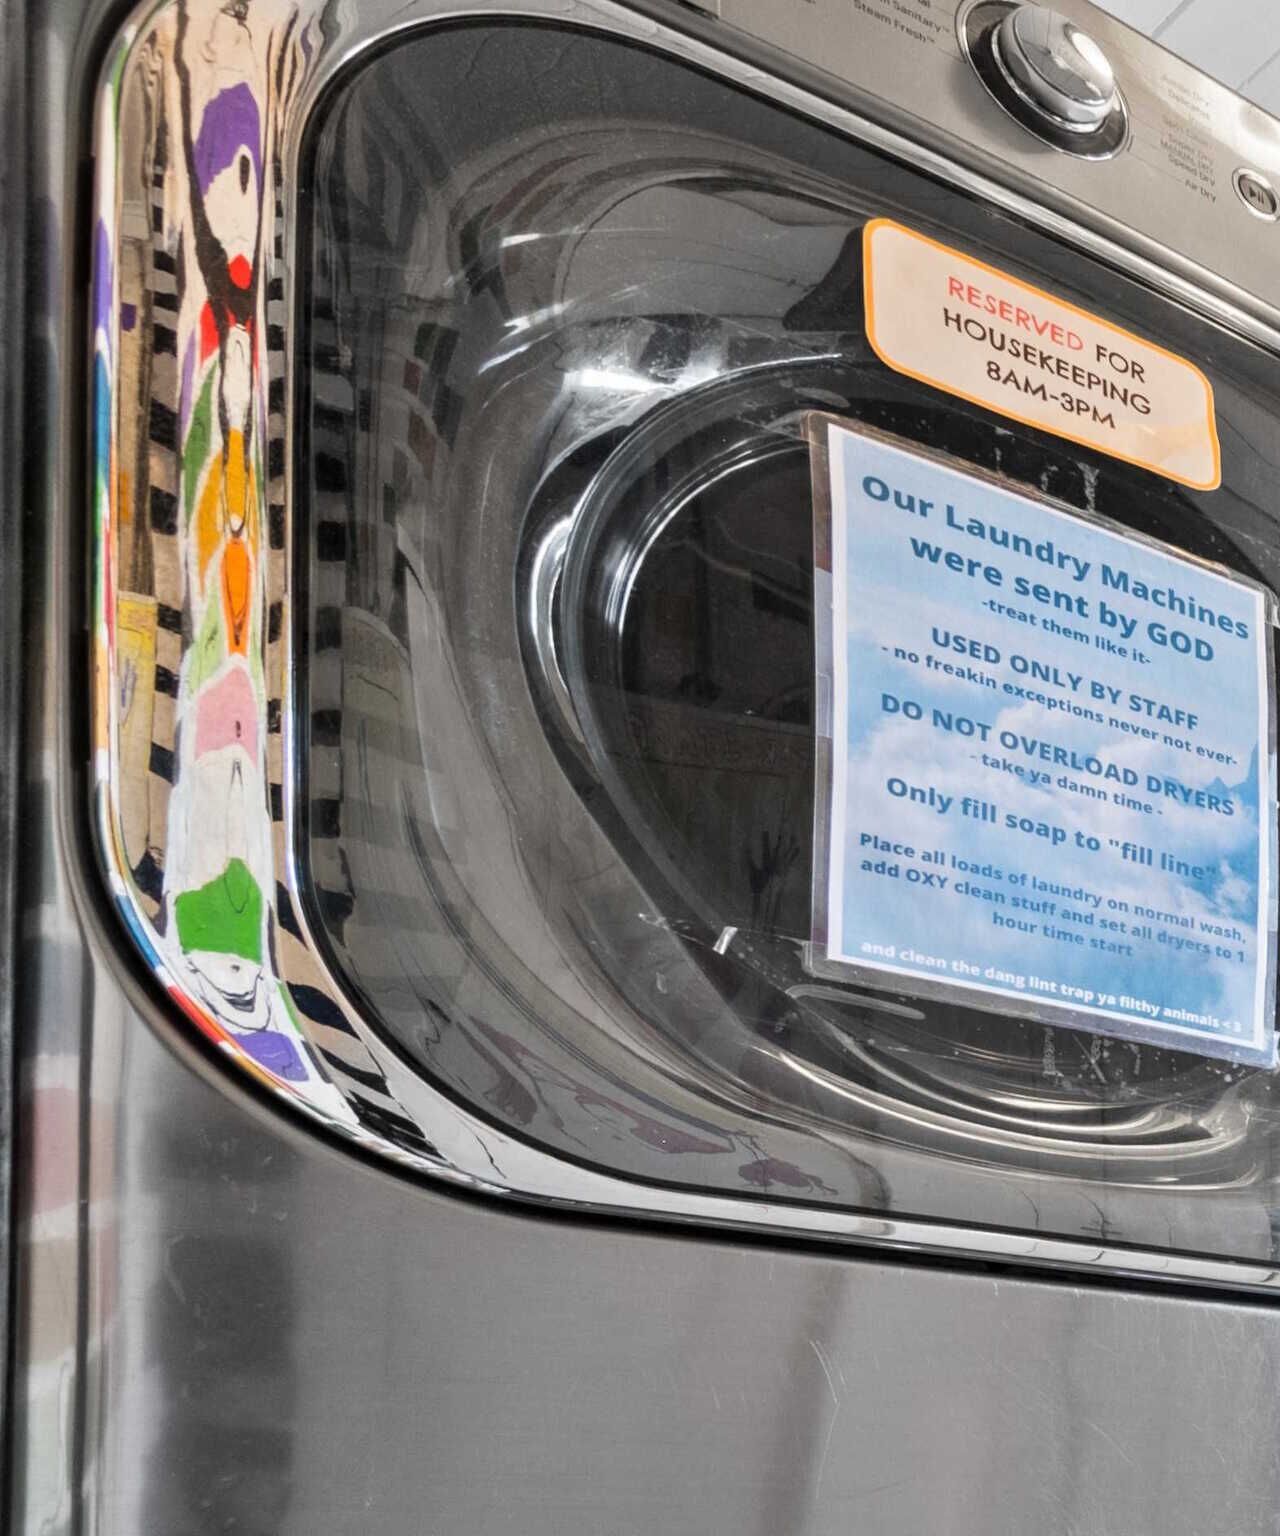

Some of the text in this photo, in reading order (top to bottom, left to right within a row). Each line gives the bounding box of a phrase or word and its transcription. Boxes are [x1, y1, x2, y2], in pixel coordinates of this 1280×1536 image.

[942, 308, 1151, 415] HOUSEKEEPING
[947, 276, 1145, 383] RESERVED FOR
[986, 360, 1116, 429] 8AM-3PM
[861, 474, 1249, 639] Our Laundry Machines
[909, 536, 1215, 663] were sent by GOD
[932, 627, 1199, 731] USED ONLY BY STAFF
[981, 599, 1151, 665] -treat them like it-
[881, 693, 1235, 816] DO NOT OVERLOAD DRYERS
[894, 646, 1238, 767] no freakin exceptions never not ever-
[886, 776, 1217, 880] Only fill soap to "fill line"
[981, 752, 1153, 815] take ya damn time
[860, 833, 1247, 944] Place all loads of laundry on normal wash,
[860, 857, 1246, 963] add OXY clean stuff and set all dryers to 1
[992, 911, 1134, 959] hour time start
[861, 940, 1220, 1029] and clean the dang lint trap ya filthy animals
